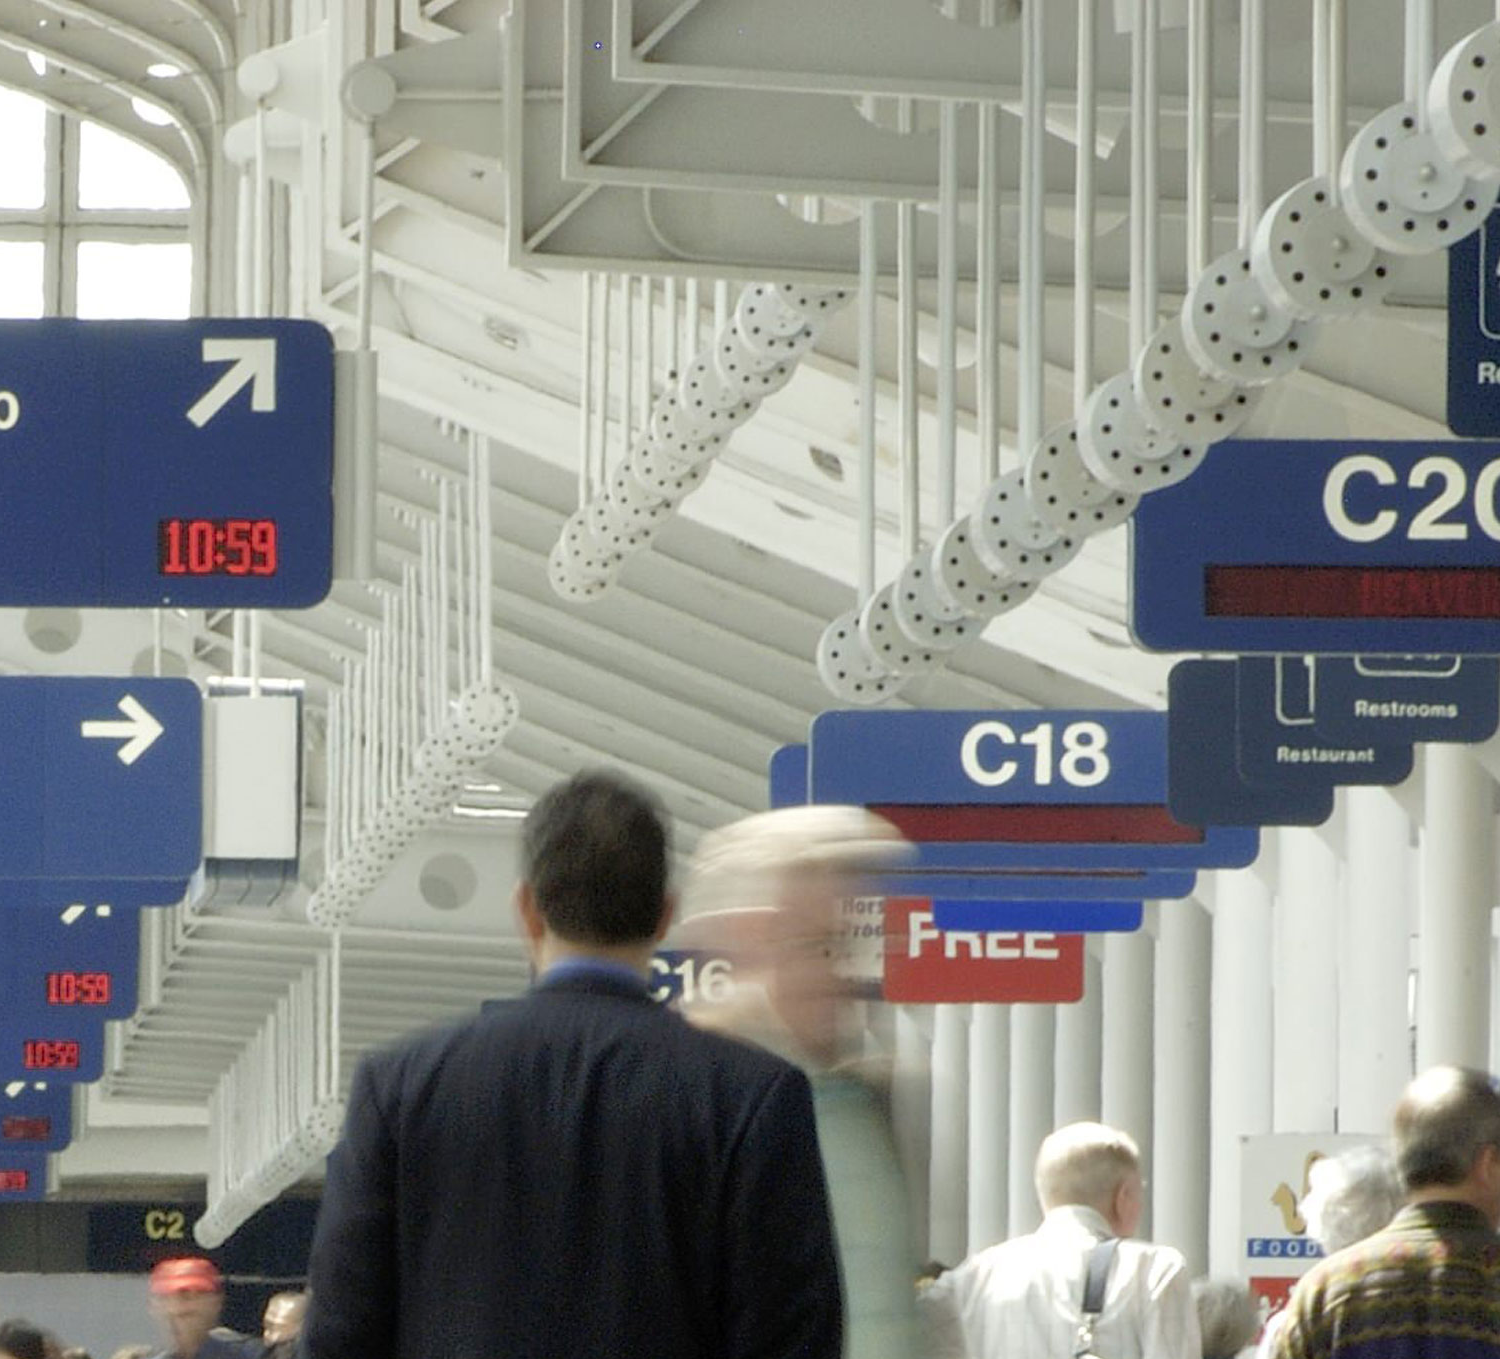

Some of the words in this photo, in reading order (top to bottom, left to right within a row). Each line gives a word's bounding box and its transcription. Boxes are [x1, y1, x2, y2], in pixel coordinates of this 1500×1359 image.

[163, 519, 277, 575] 10:59
[1355, 700, 1459, 719] Restrooms
[961, 722, 1111, 788] C18
[1277, 746, 1376, 764] Restaurant
[145, 1210, 185, 1240] C2
